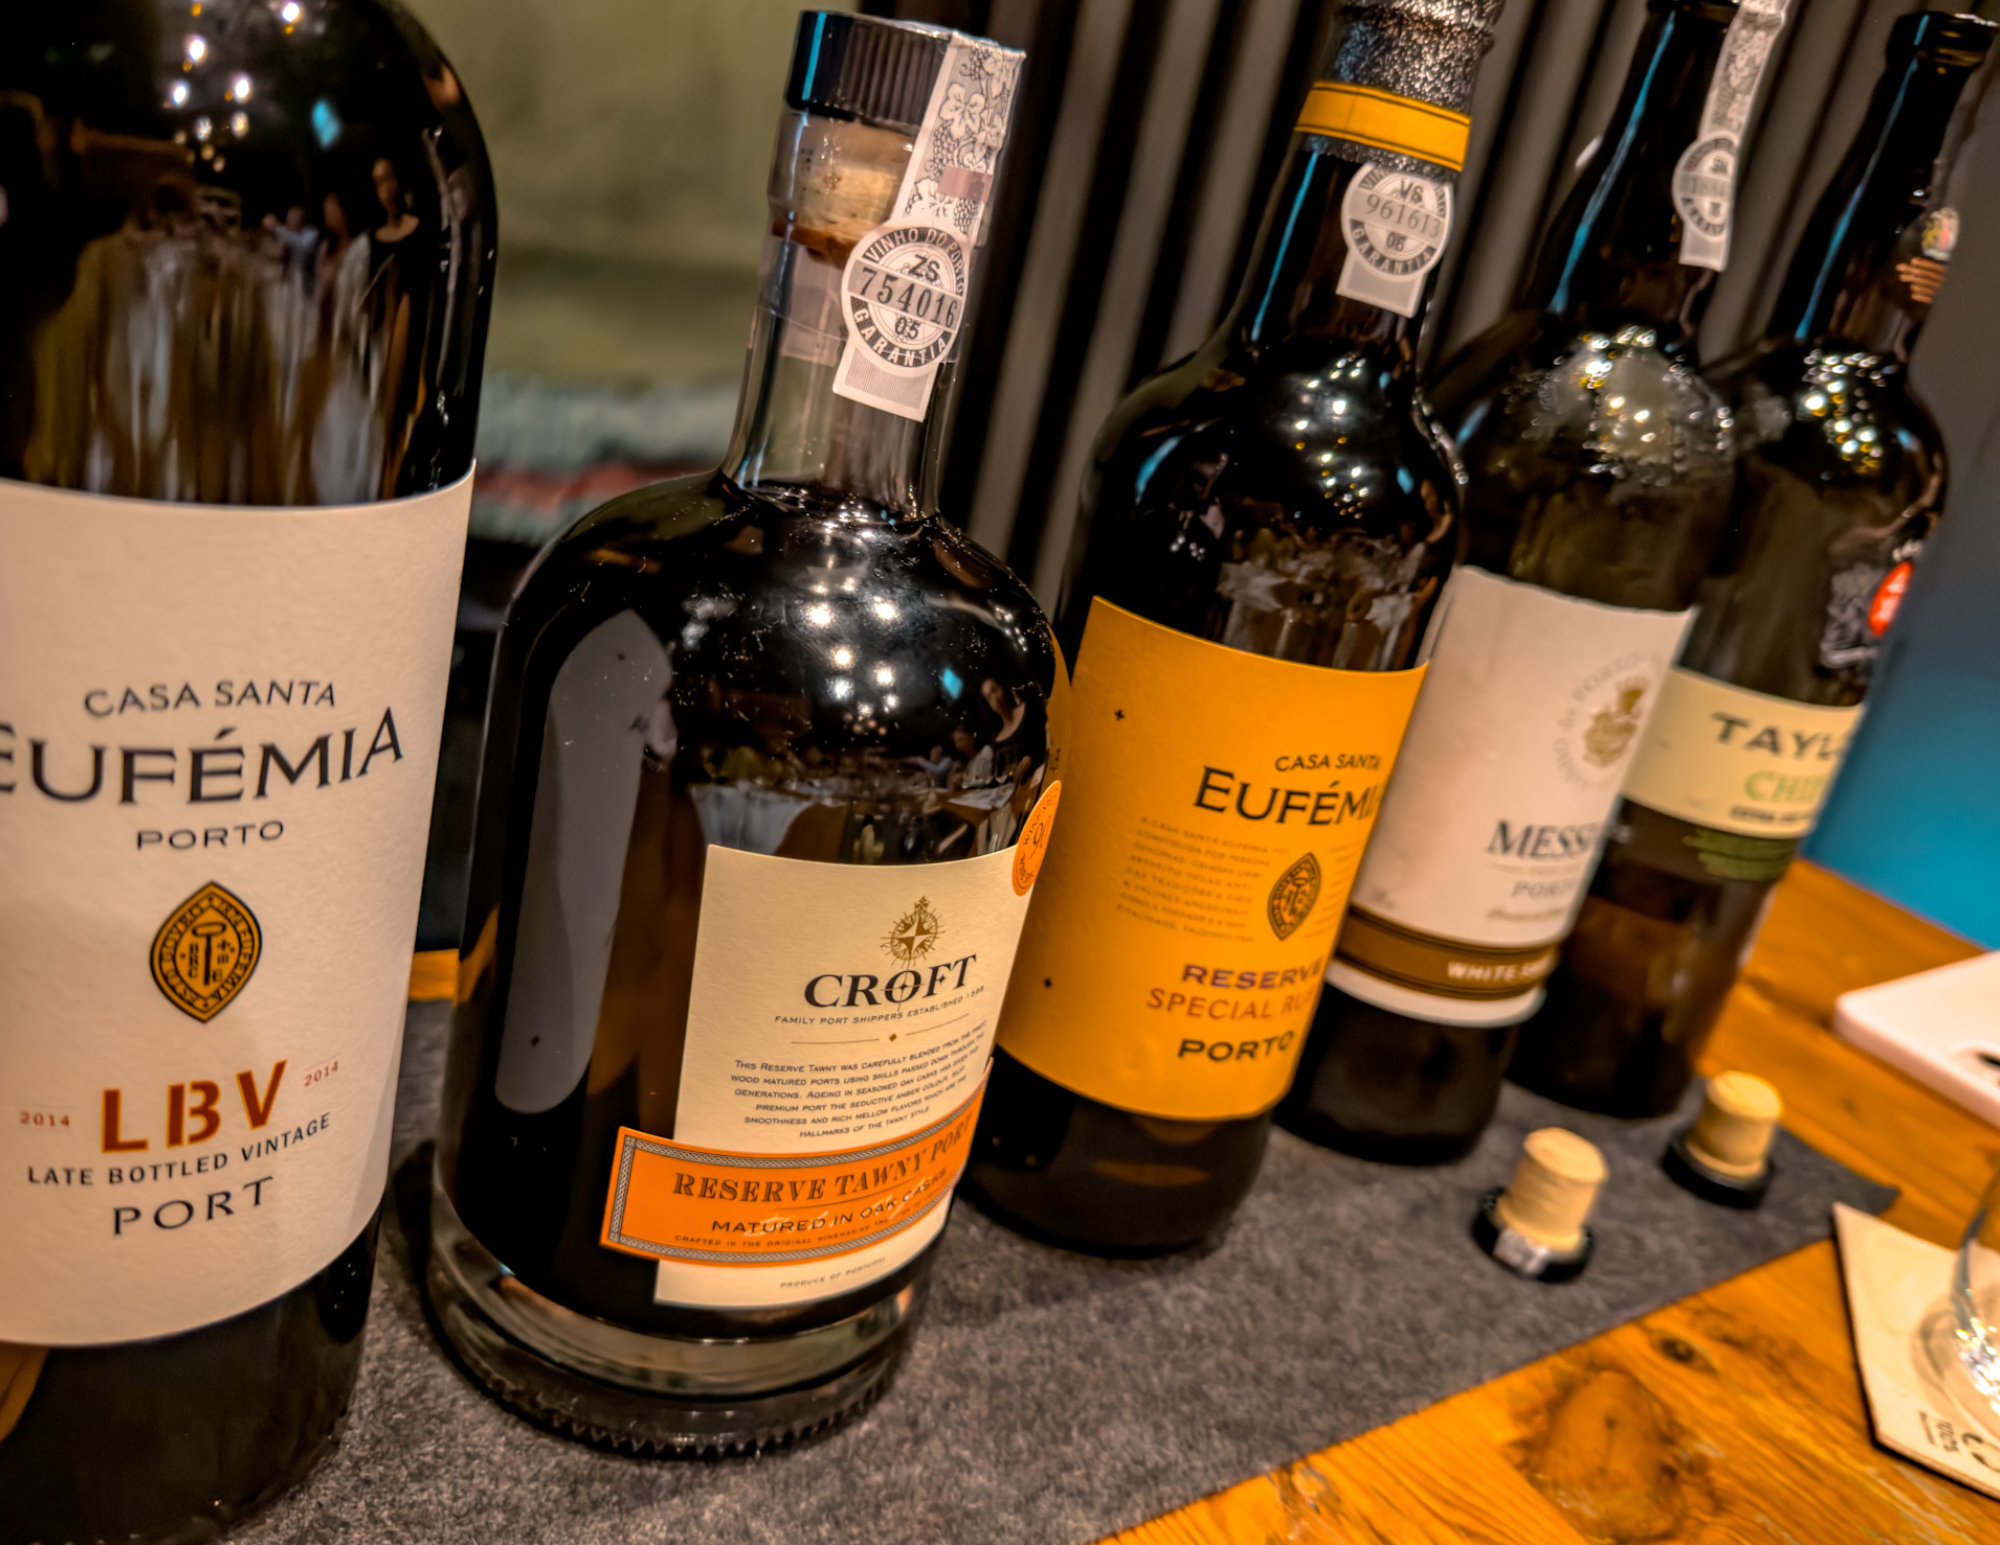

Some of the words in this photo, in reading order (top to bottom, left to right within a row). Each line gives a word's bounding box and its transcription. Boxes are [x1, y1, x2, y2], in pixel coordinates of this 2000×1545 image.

[1365, 193, 1441, 239] 961613
[863, 228, 919, 264] VINHO
[924, 227, 947, 247] DO
[948, 242, 966, 293] PORTO
[1352, 228, 1432, 275] GARANTIA
[908, 254, 941, 283] ZS
[860, 267, 958, 328] 754016
[853, 308, 947, 367] GARANTIA
[84, 681, 203, 718] CASA
[214, 679, 337, 708] SANTA
[1275, 754, 1331, 772] CASA
[1335, 753, 1381, 772] SANTA
[137, 820, 285, 851] PORTO
[803, 953, 978, 1008] CROFT
[1446, 961, 1517, 982] WHITE
[775, 1015, 816, 1025] FAMILY
[820, 1017, 850, 1026] PORT
[852, 1011, 904, 1024] SHIPPERS
[907, 995, 965, 1018] ESTABLISHED
[1146, 987, 1274, 1021] SPECIAL
[735, 1060, 757, 1070] THIS
[760, 1062, 805, 1073] RESERVE
[808, 1064, 838, 1073] TAWNY
[840, 1063, 858, 1072] WAS
[861, 1056, 907, 1070] CAREFULLY
[909, 1045, 941, 1061] BLENDED
[1177, 1030, 1296, 1063] PORTO
[303, 1060, 340, 1088] 2014
[731, 1074, 760, 1084] WOOD
[763, 1077, 807, 1086] MATURED
[810, 1078, 841, 1086] PORTS
[843, 1075, 870, 1085] USING
[872, 1069, 899, 1081] SKILLS
[901, 1062, 929, 1074] PASSED
[734, 1088, 802, 1100] GENERATIONS.
[806, 1090, 841, 1099] AGEING
[844, 1089, 853, 1097] IN
[856, 1082, 898, 1096] SEASONED
[899, 1078, 915, 1087] OAK
[916, 1069, 938, 1082] CASKS
[101, 1059, 289, 1154] LBV
[744, 1116, 808, 1125] SMOOTHNESS
[810, 1116, 829, 1124] AND
[831, 1114, 852, 1123] RICH
[855, 1108, 889, 1121] MELLOW
[890, 1098, 922, 1113] FLAVORS
[755, 1104, 799, 1112] PREMIUM
[802, 1104, 828, 1112] PORT
[830, 1102, 847, 1110] THE
[849, 1095, 894, 1109] SEDUCTIVE
[895, 1086, 920, 1100] AMBER
[19, 1110, 71, 1129] 2014
[799, 1127, 850, 1138] HALLMARKS
[852, 1124, 865, 1133] OF
[868, 1121, 883, 1130] THE
[28, 1165, 94, 1186] LATE
[108, 1152, 229, 1186] BOTTLED
[240, 1112, 332, 1163] VINTAGE
[672, 1172, 826, 1203] RESERVE
[834, 1148, 928, 1197] TAWNY
[929, 1110, 974, 1164] PORT
[113, 1176, 275, 1237] PORT
[711, 1217, 826, 1233] MATURED
[833, 1211, 854, 1227] IN
[860, 1197, 898, 1220] OAK
[902, 1166, 948, 1203] CASKS
[674, 1234, 722, 1246] CRAFTED
